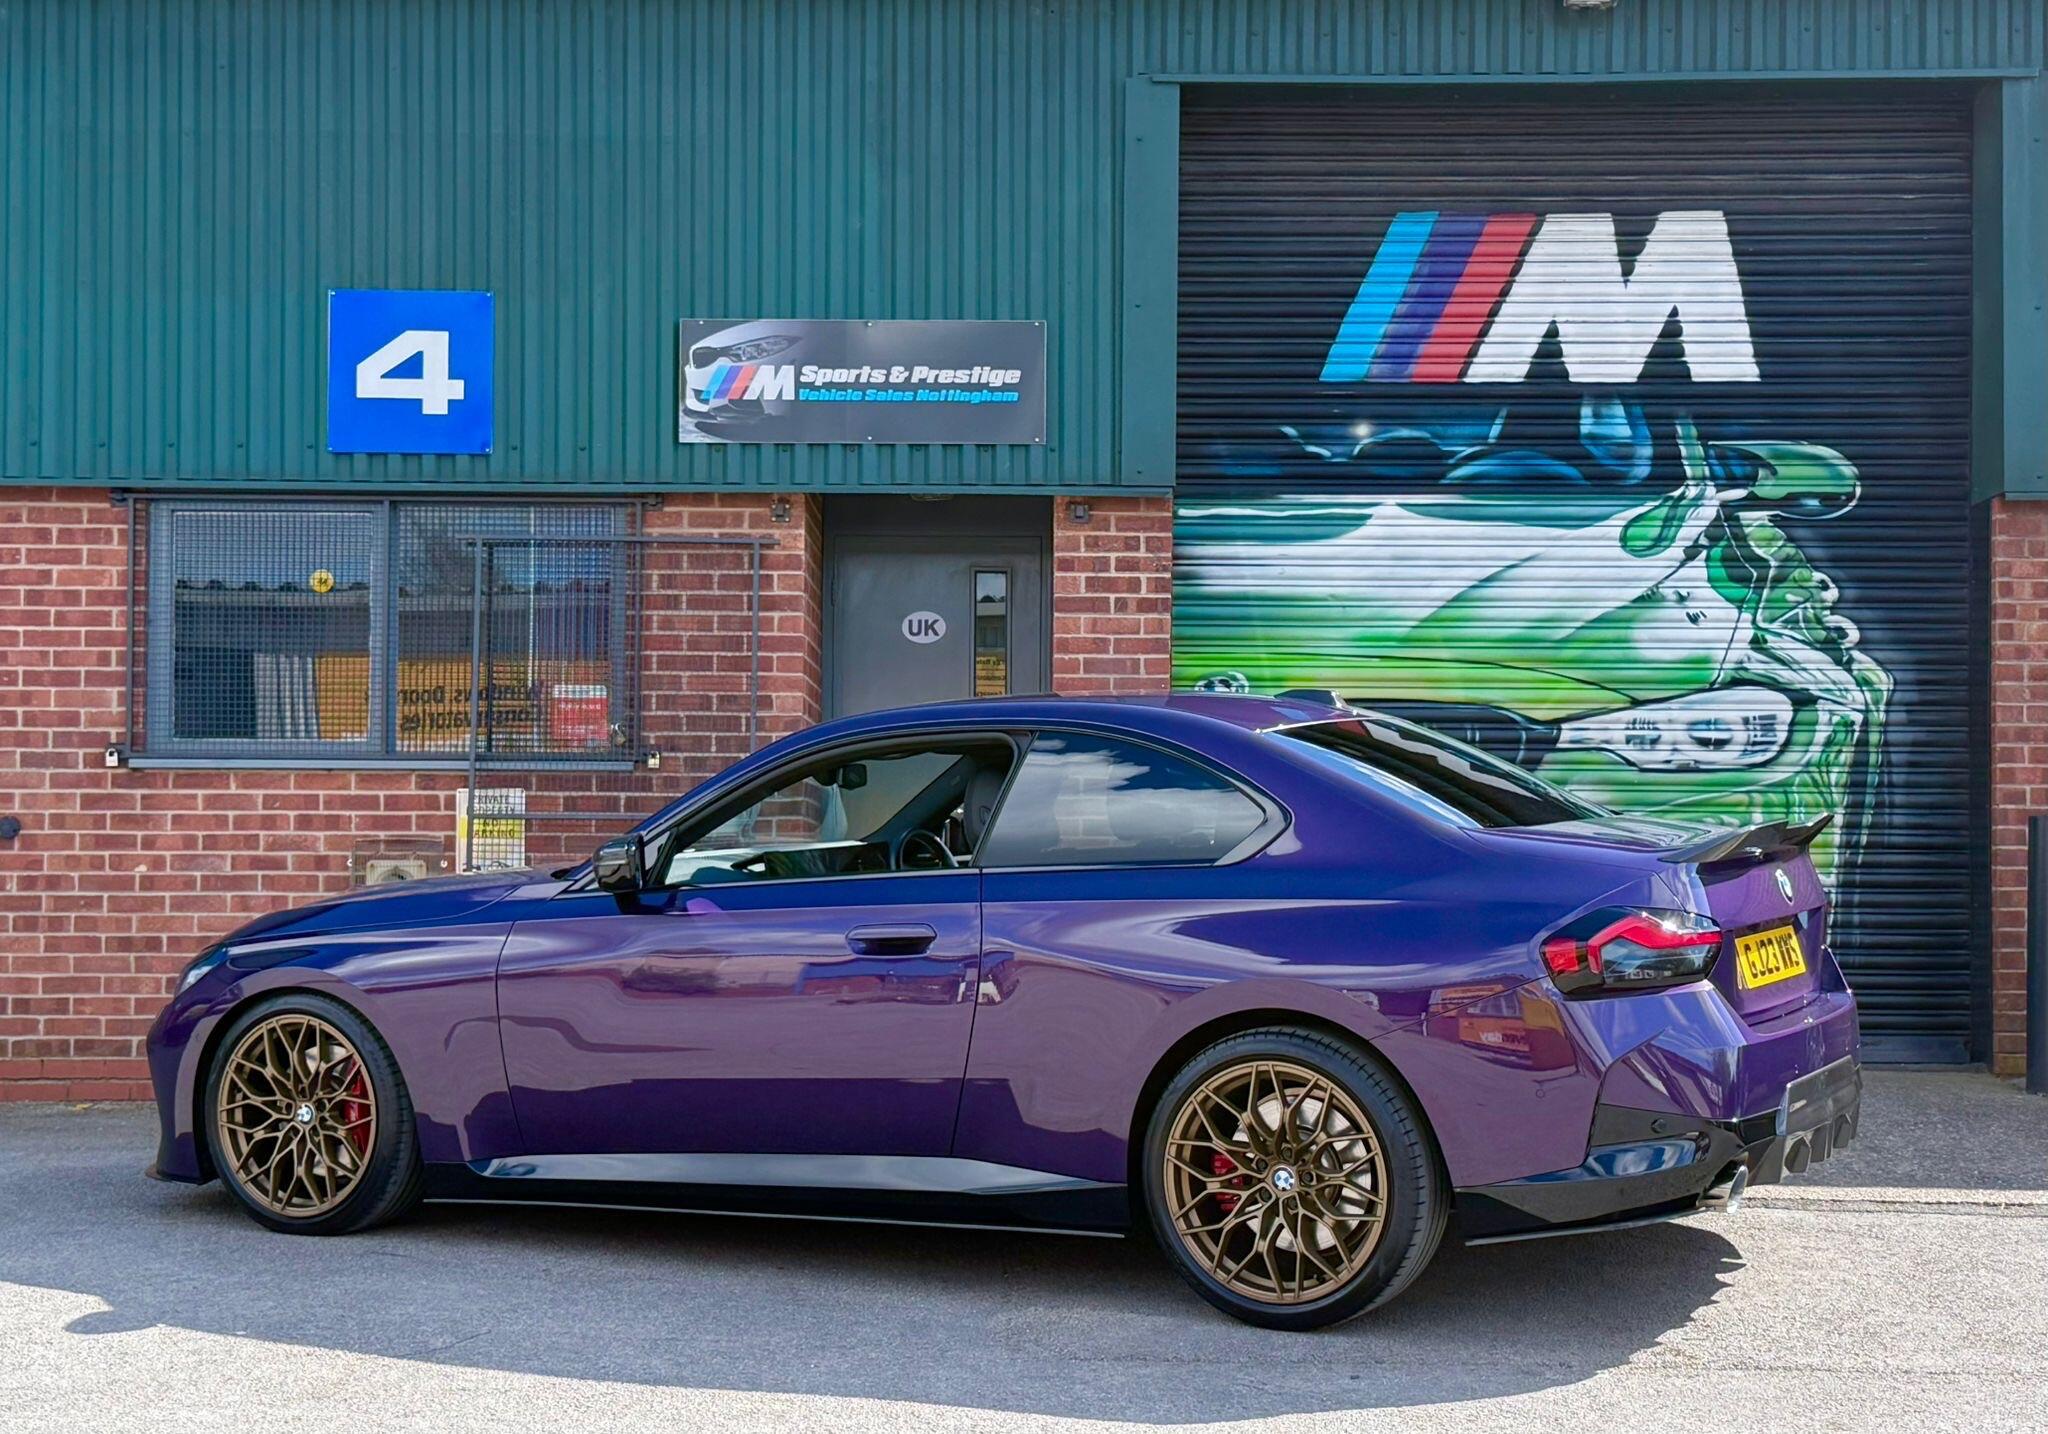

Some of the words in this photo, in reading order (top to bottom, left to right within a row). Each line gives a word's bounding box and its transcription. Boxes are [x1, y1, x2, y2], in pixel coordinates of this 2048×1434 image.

[1462, 210, 1761, 383] M
[356, 330, 465, 415] 4
[742, 365, 796, 400] M
[800, 365, 887, 386] Sports
[889, 365, 909, 384] &
[911, 365, 1022, 387] Prestige
[799, 388, 863, 402] Vehicle
[865, 389, 915, 402] Sales
[916, 389, 1020, 404] Nottingham
[908, 619, 940, 637] UK
[474, 829, 515, 839] ARKING
